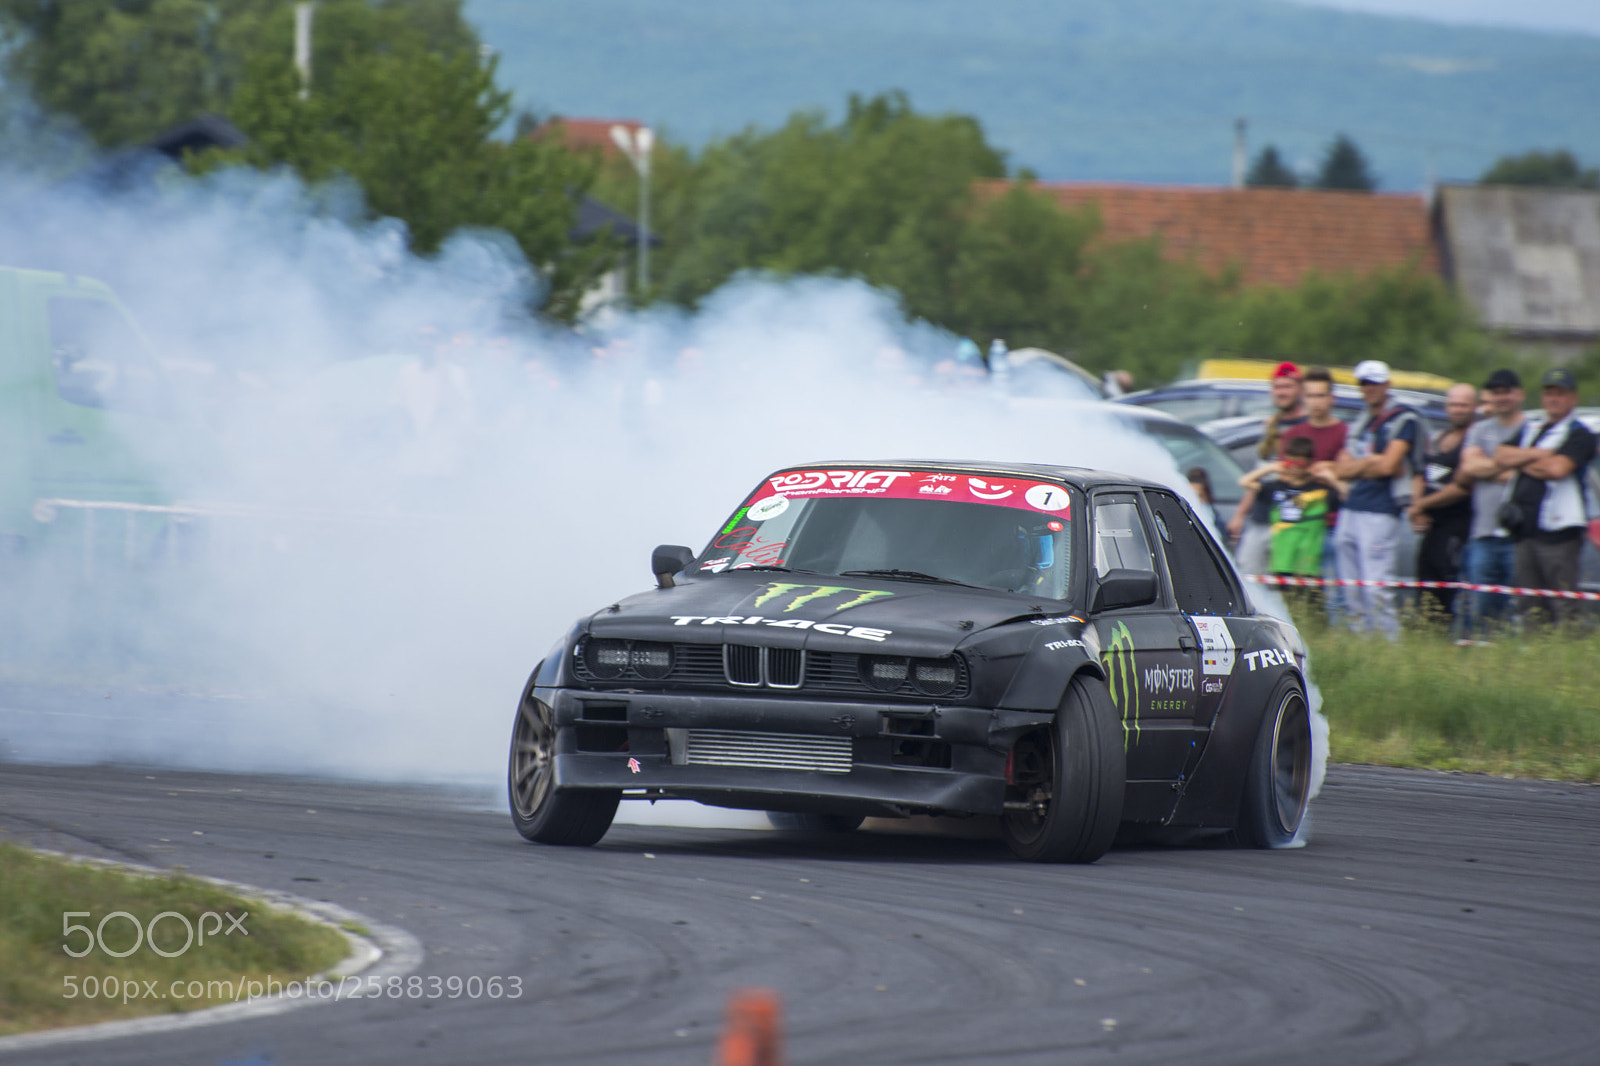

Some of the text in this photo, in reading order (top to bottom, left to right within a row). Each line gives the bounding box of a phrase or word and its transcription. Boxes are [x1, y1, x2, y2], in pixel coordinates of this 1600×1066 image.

[1043, 491, 1053, 506] 1
[670, 615, 893, 642] TRI-ACE
[1150, 700, 1188, 711] ENERGY
